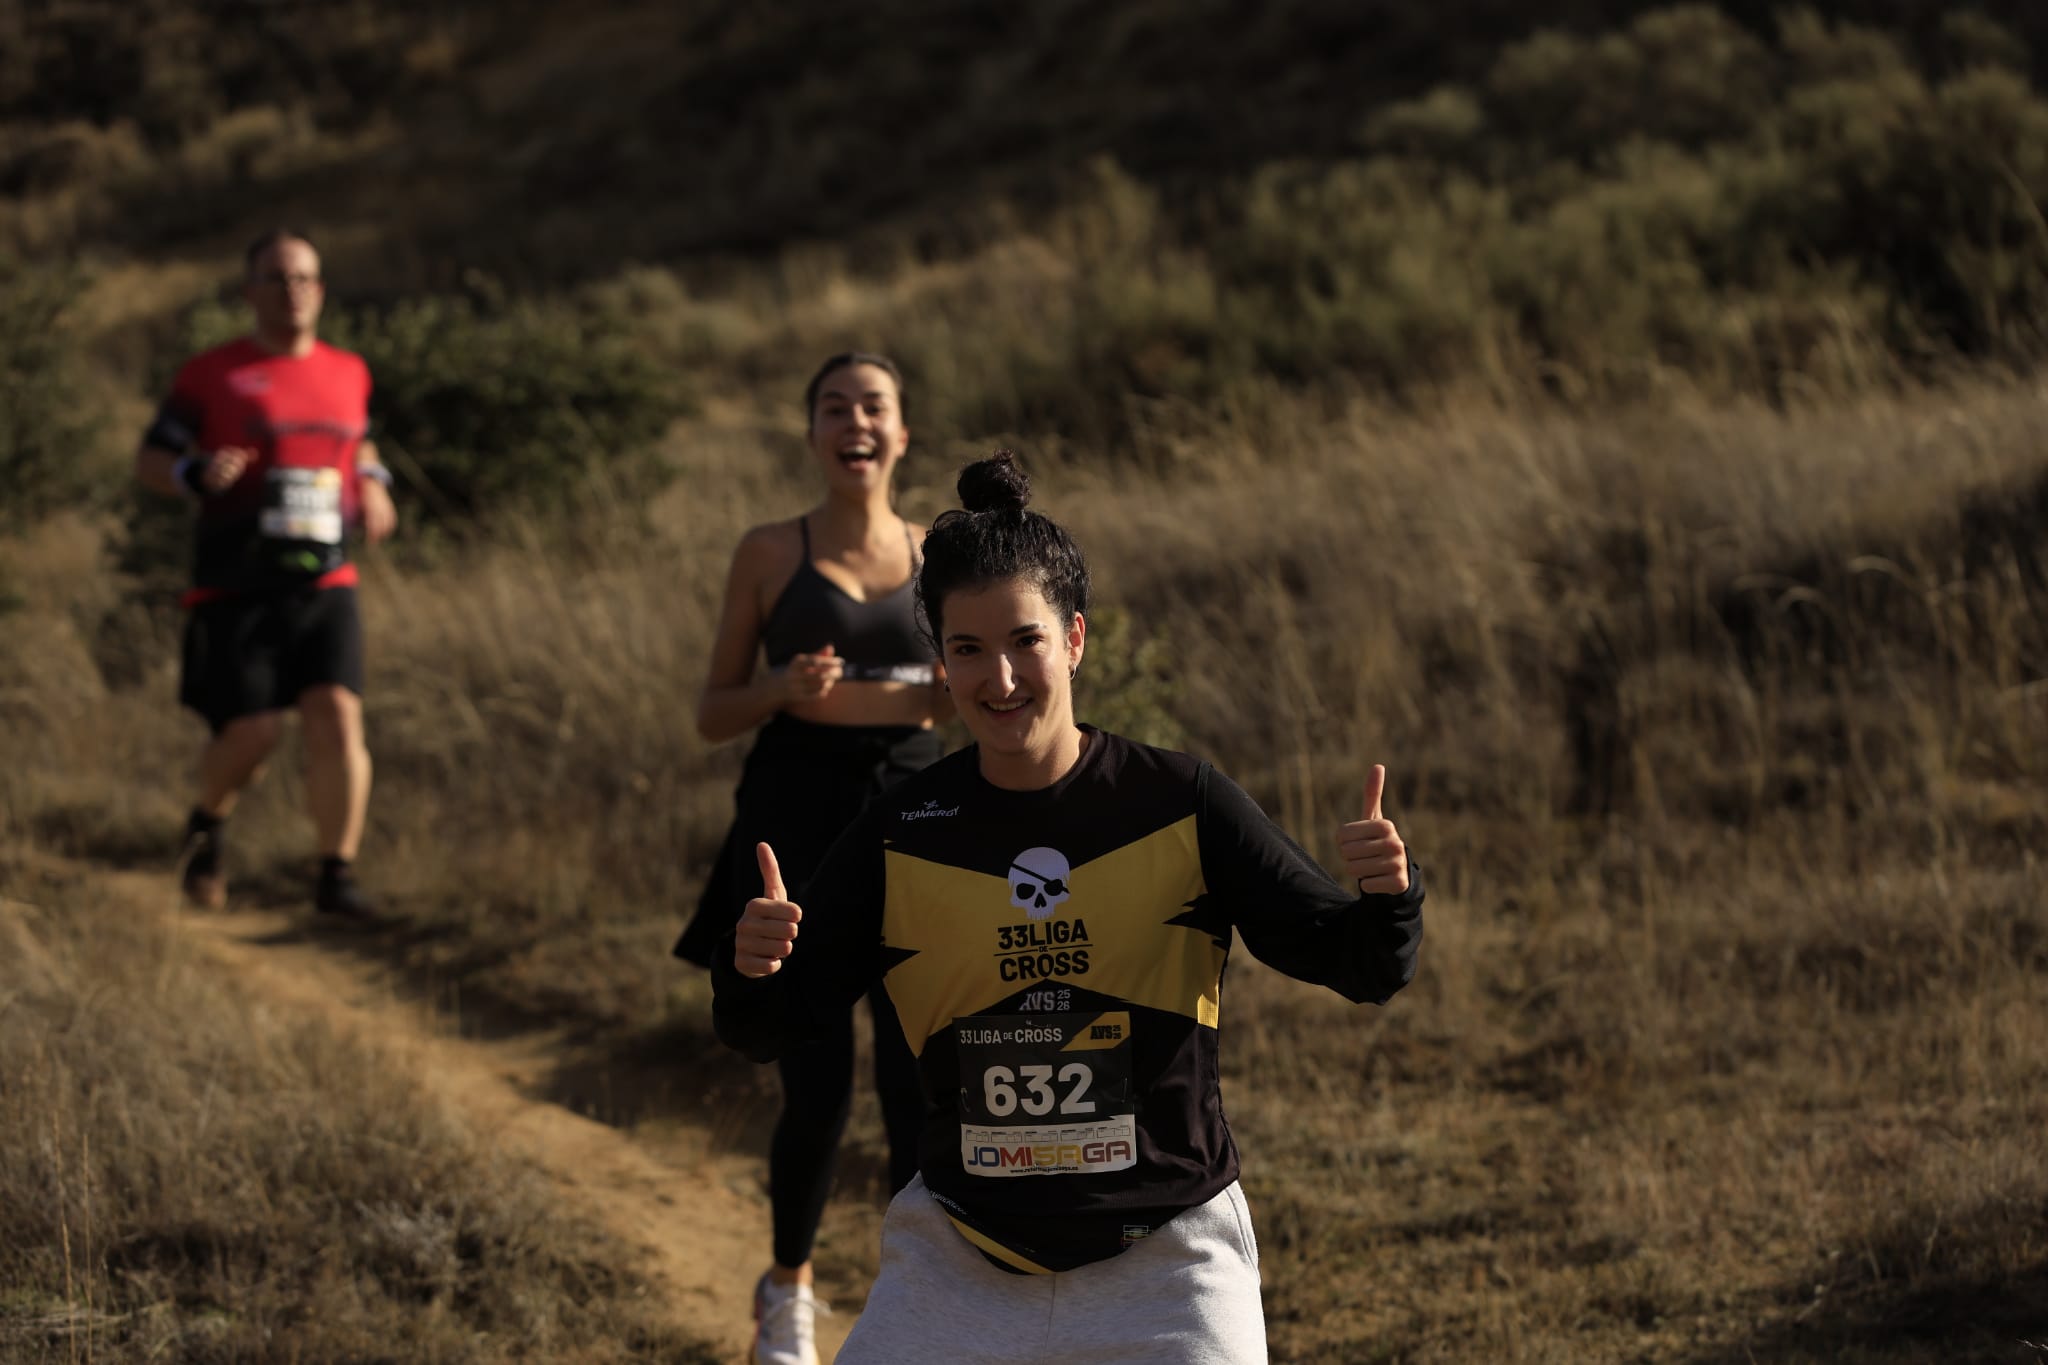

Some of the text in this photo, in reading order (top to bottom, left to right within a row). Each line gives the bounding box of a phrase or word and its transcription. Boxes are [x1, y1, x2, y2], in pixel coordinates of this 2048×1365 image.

[901, 806, 960, 821] TEAMERGY
[999, 950, 1089, 982] CROSS
[1057, 989, 1071, 999] 25
[1057, 1001, 1070, 1011] 26
[1003, 1032, 1013, 1040] DE
[1014, 1027, 1063, 1044] CROSS
[983, 1062, 1096, 1117] 632
[967, 1140, 1131, 1168] JOMISAGA
